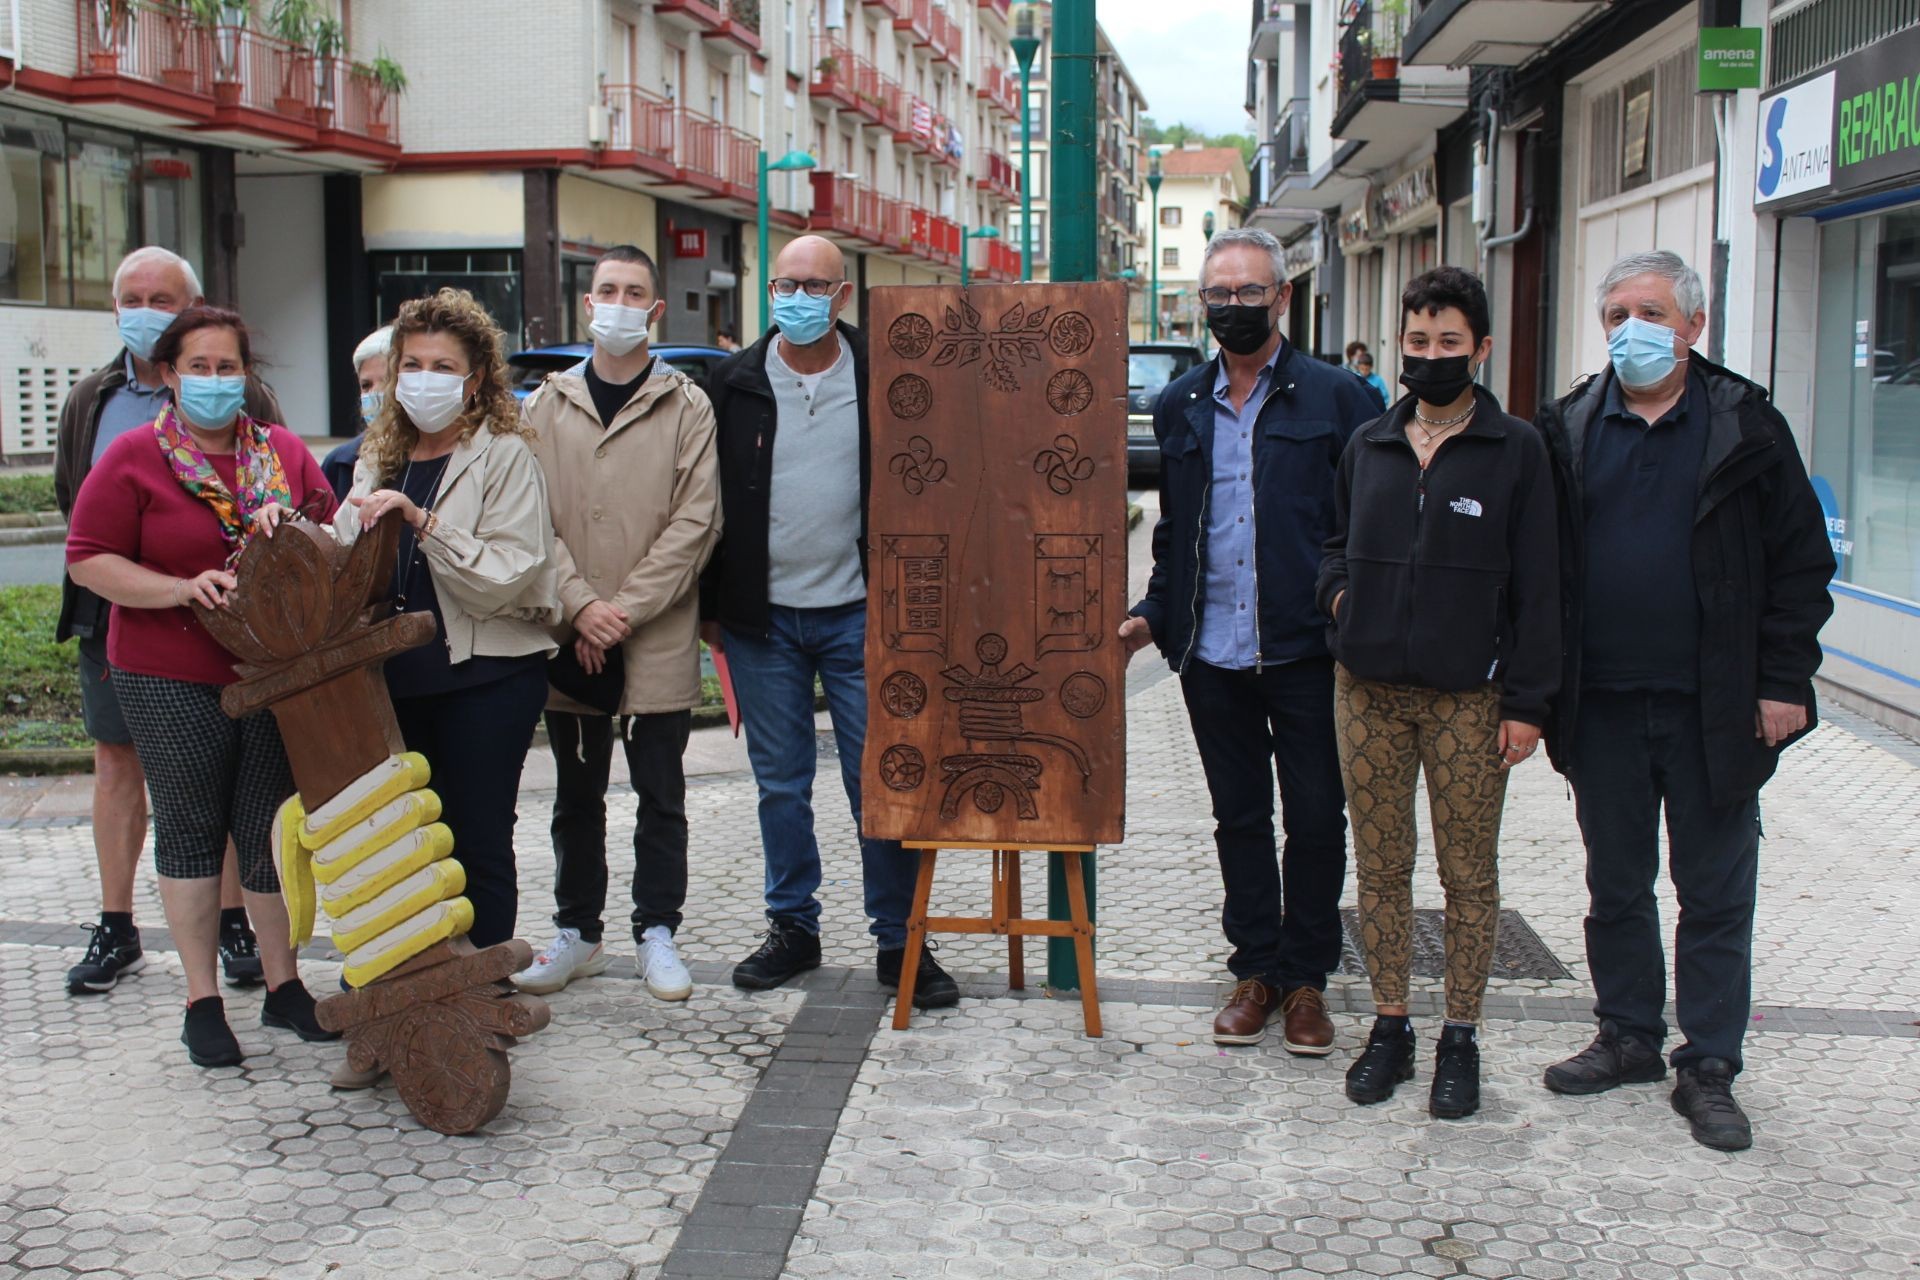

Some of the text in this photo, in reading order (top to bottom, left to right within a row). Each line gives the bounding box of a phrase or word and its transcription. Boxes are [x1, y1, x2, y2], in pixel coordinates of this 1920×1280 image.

[1703, 49, 1755, 60] amena
[1449, 500, 1472, 510] NORTH
[1460, 496, 1472, 505] THE
[1453, 507, 1470, 515] FACE
